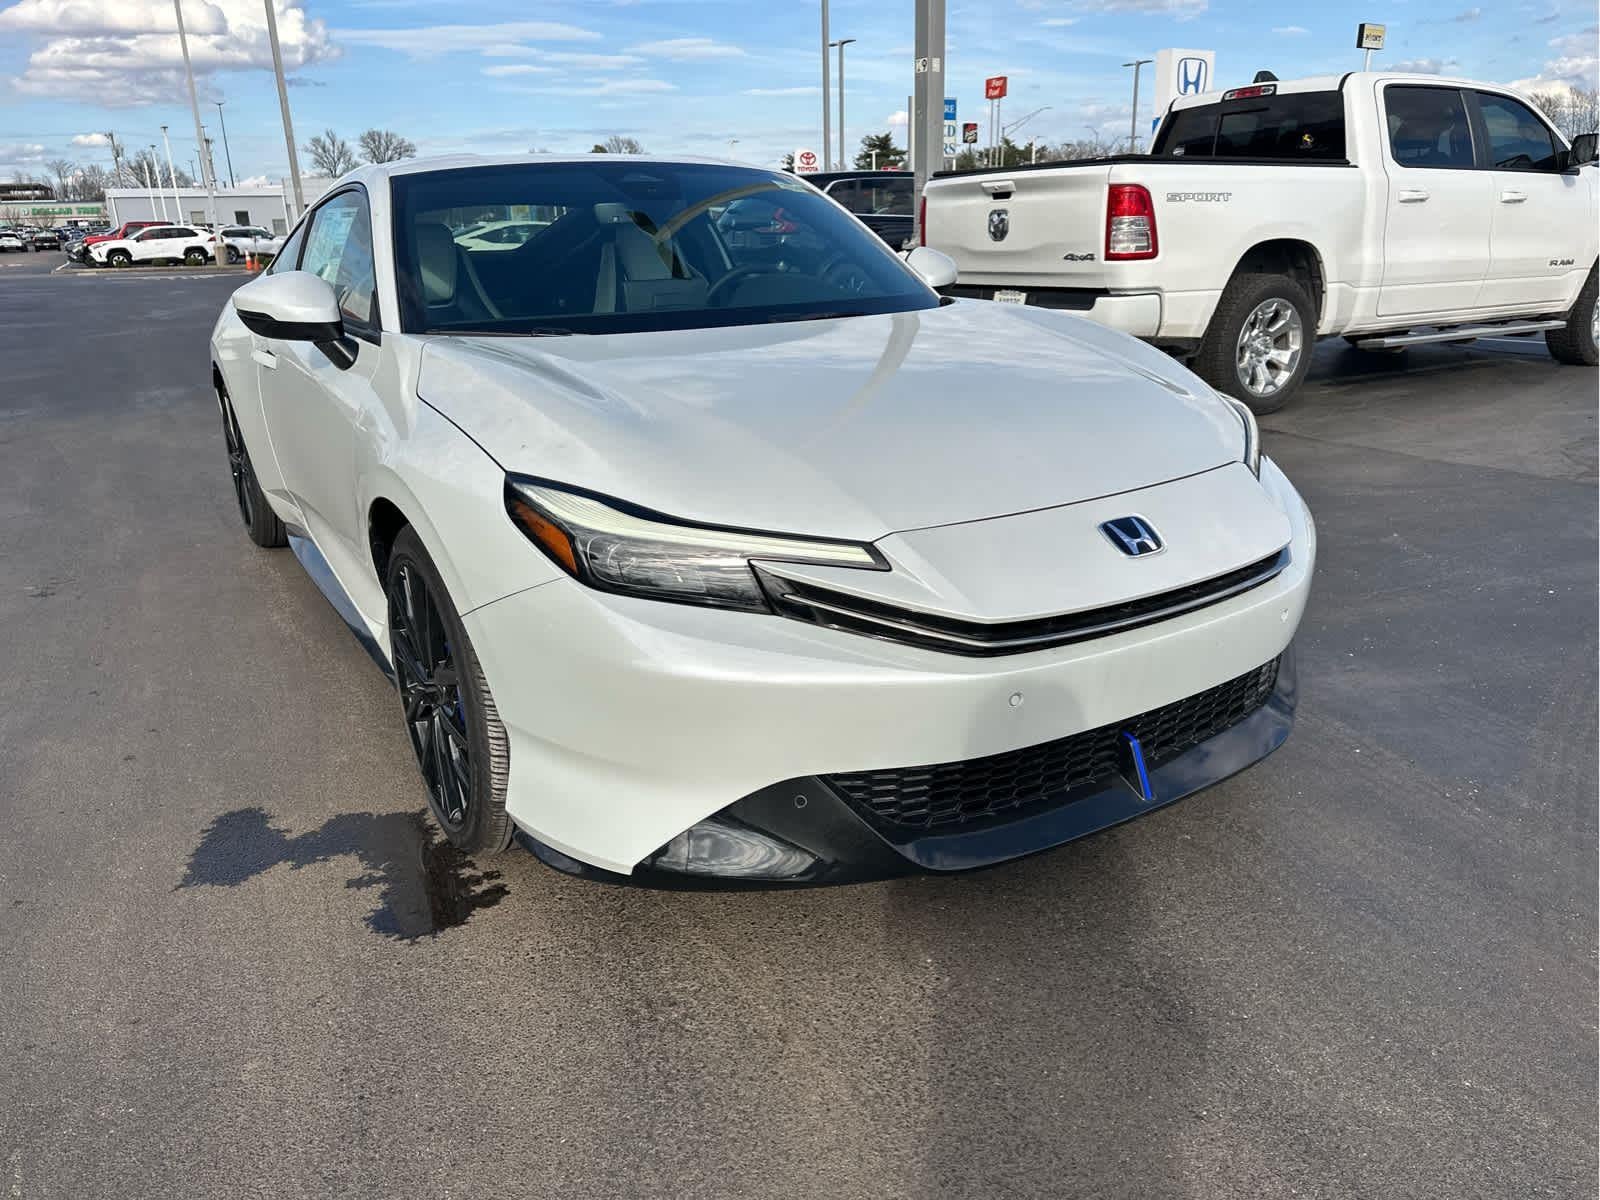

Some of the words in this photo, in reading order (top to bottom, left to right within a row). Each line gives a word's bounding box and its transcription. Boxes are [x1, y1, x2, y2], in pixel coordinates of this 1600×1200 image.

[1167, 192, 1232, 202] SPORT
[31, 207, 73, 215] DOLLAR
[1549, 259, 1575, 267] RAM
